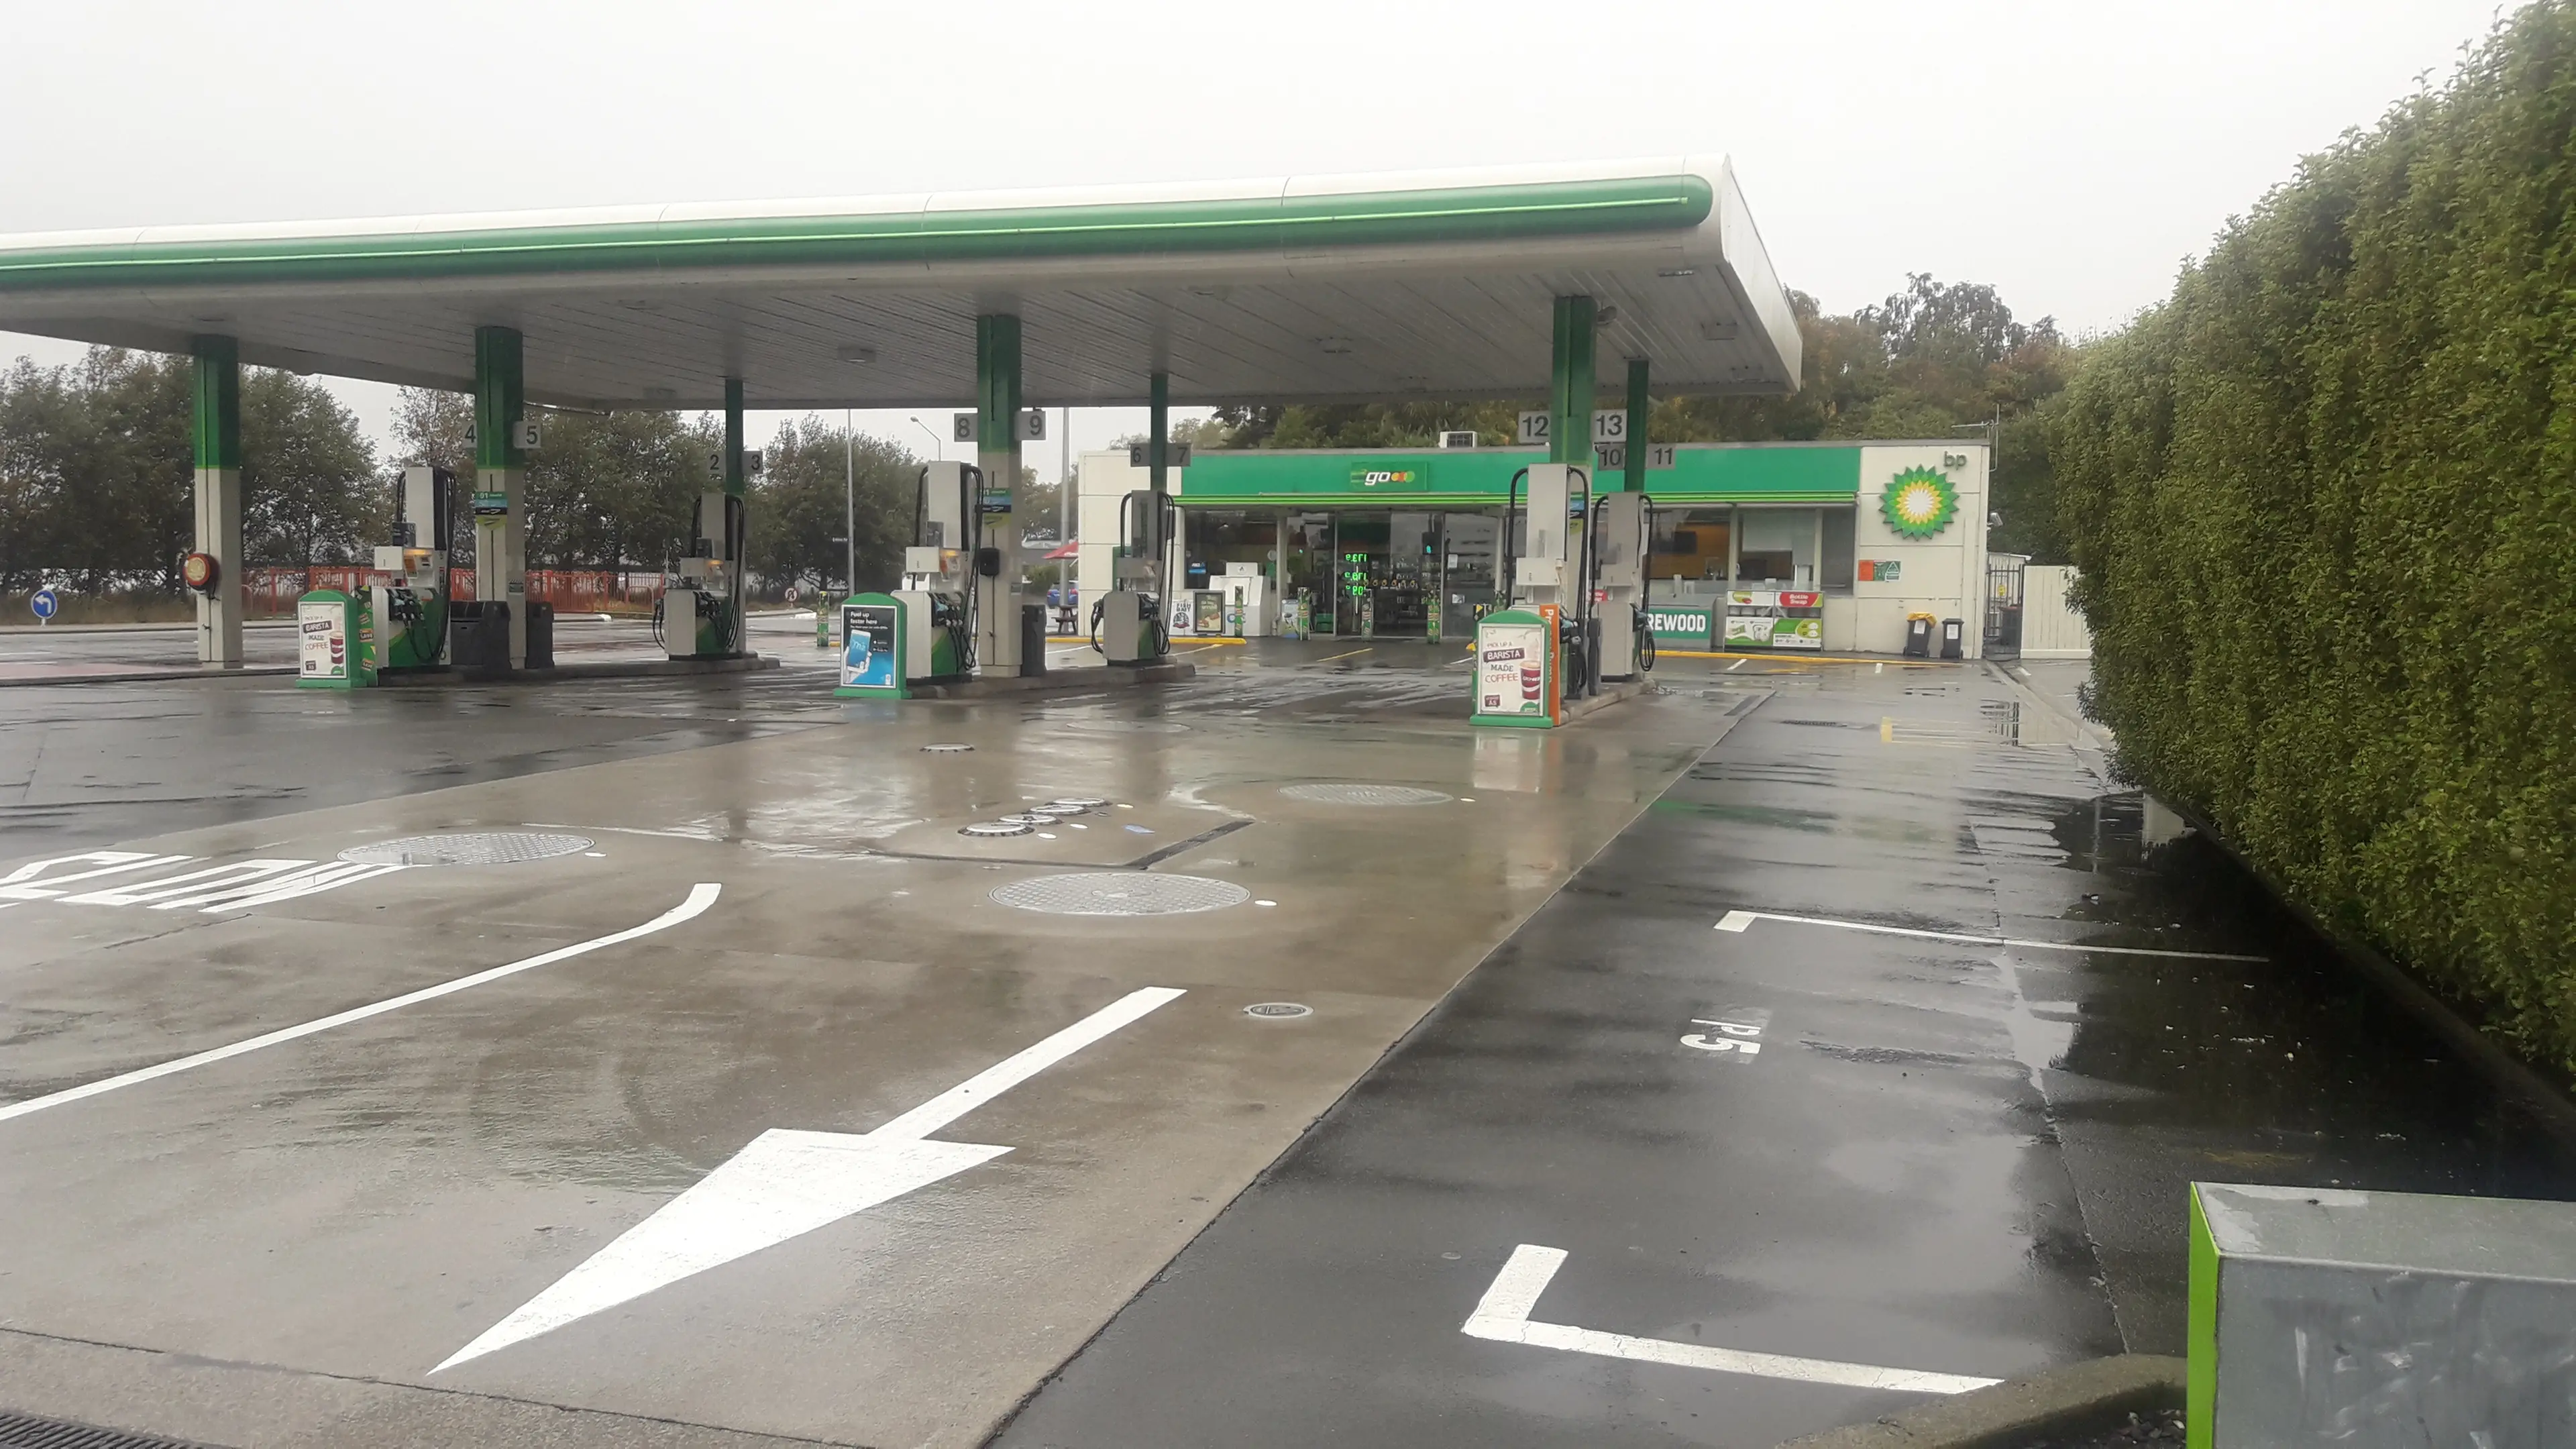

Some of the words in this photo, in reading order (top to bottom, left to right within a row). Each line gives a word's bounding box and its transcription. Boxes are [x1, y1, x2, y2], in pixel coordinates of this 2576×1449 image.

[465, 423, 476, 443] 4
[526, 425, 537, 445] 5
[957, 417, 971, 437] 8
[1030, 415, 1042, 436] 9
[1522, 415, 1549, 437] 12
[1596, 415, 1623, 436] 13
[710, 454, 719, 470] 2
[751, 454, 761, 470] 3
[1132, 447, 1142, 463] 6
[1177, 447, 1188, 464] 7
[1601, 448, 1621, 466] 10
[1654, 447, 1673, 465] 11
[1944, 450, 1967, 471] bp
[1648, 613, 1707, 633] REWOOD
[1487, 649, 1521, 660] BARISTA
[1485, 672, 1519, 683] COFFEE
